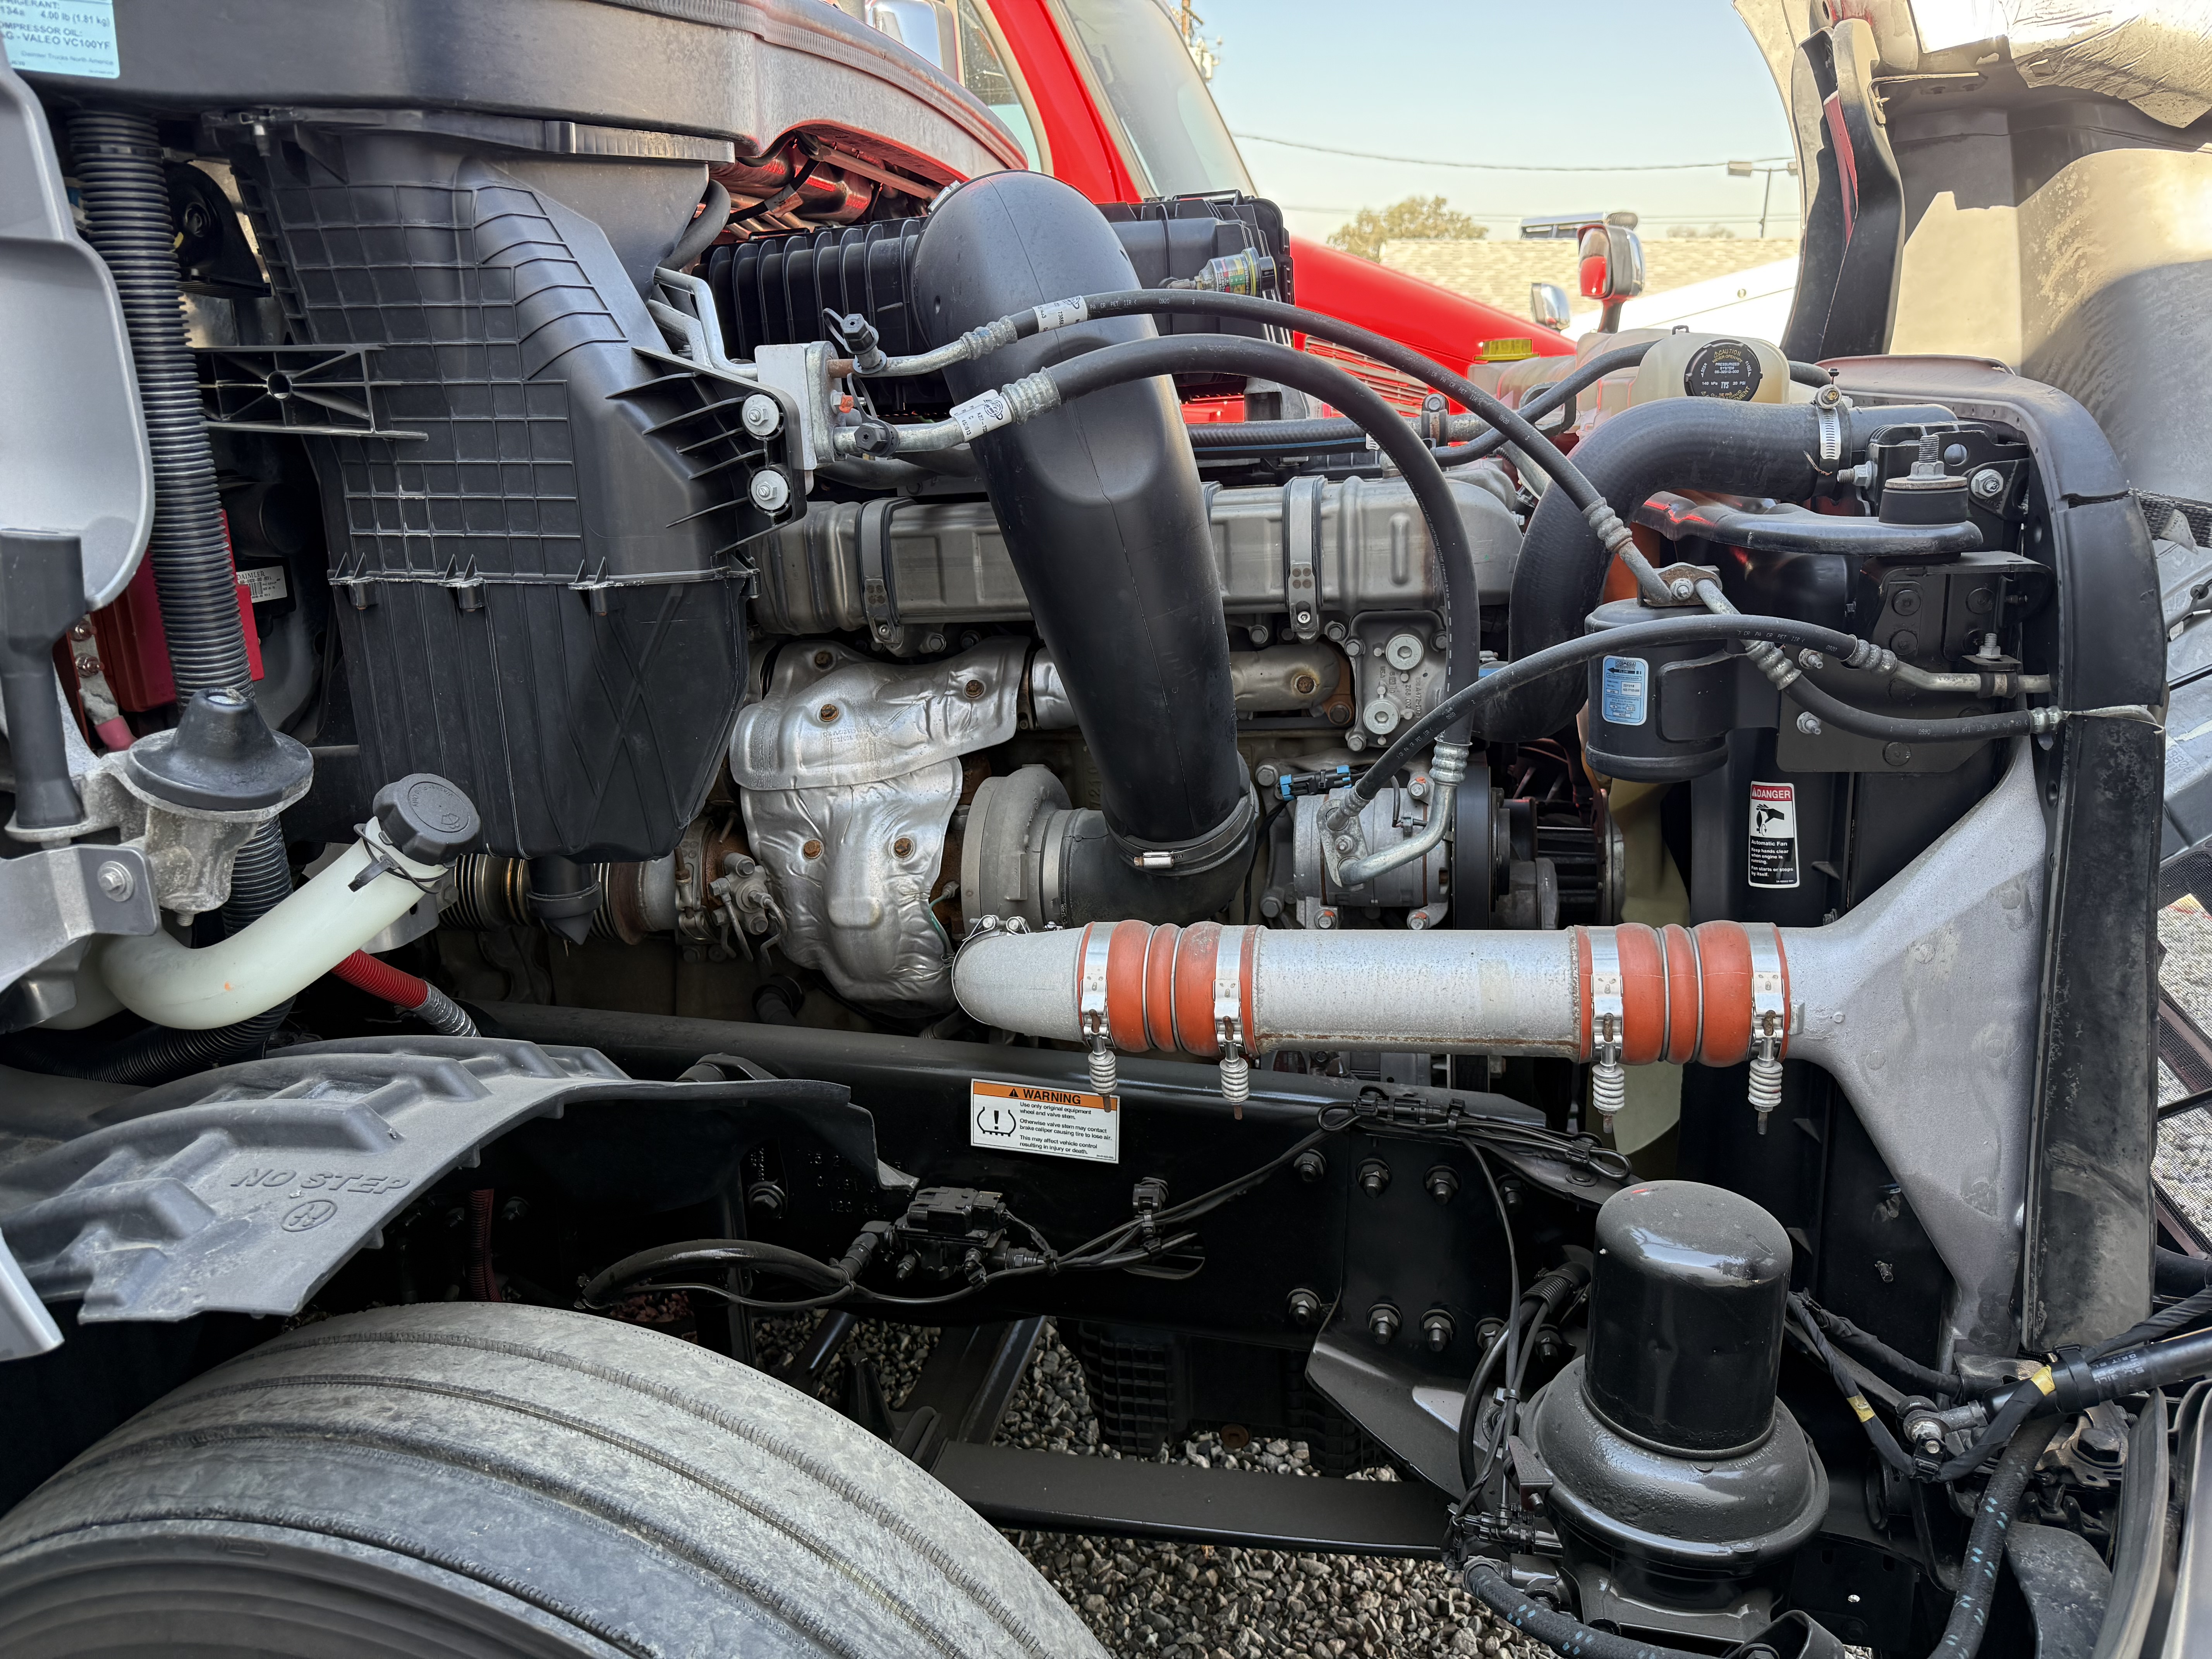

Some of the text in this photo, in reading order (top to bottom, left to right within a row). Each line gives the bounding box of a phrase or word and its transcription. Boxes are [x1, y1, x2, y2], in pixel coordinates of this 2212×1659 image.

[41, 11, 59, 19] 4.00
[96, 17, 110, 27] kg)
[63, 28, 82, 36] OIL:
[22, 33, 60, 45] VALEO
[63, 37, 110, 49] VC100YF
[1712, 355, 1725, 363] NEVER
[1429, 523, 1440, 546] SUCTION
[237, 571, 265, 580] DAIMLER
[1757, 790, 1791, 799] DANGER
[1023, 1089, 1081, 1104] WARNING
[231, 1168, 410, 1194] NO STEP
